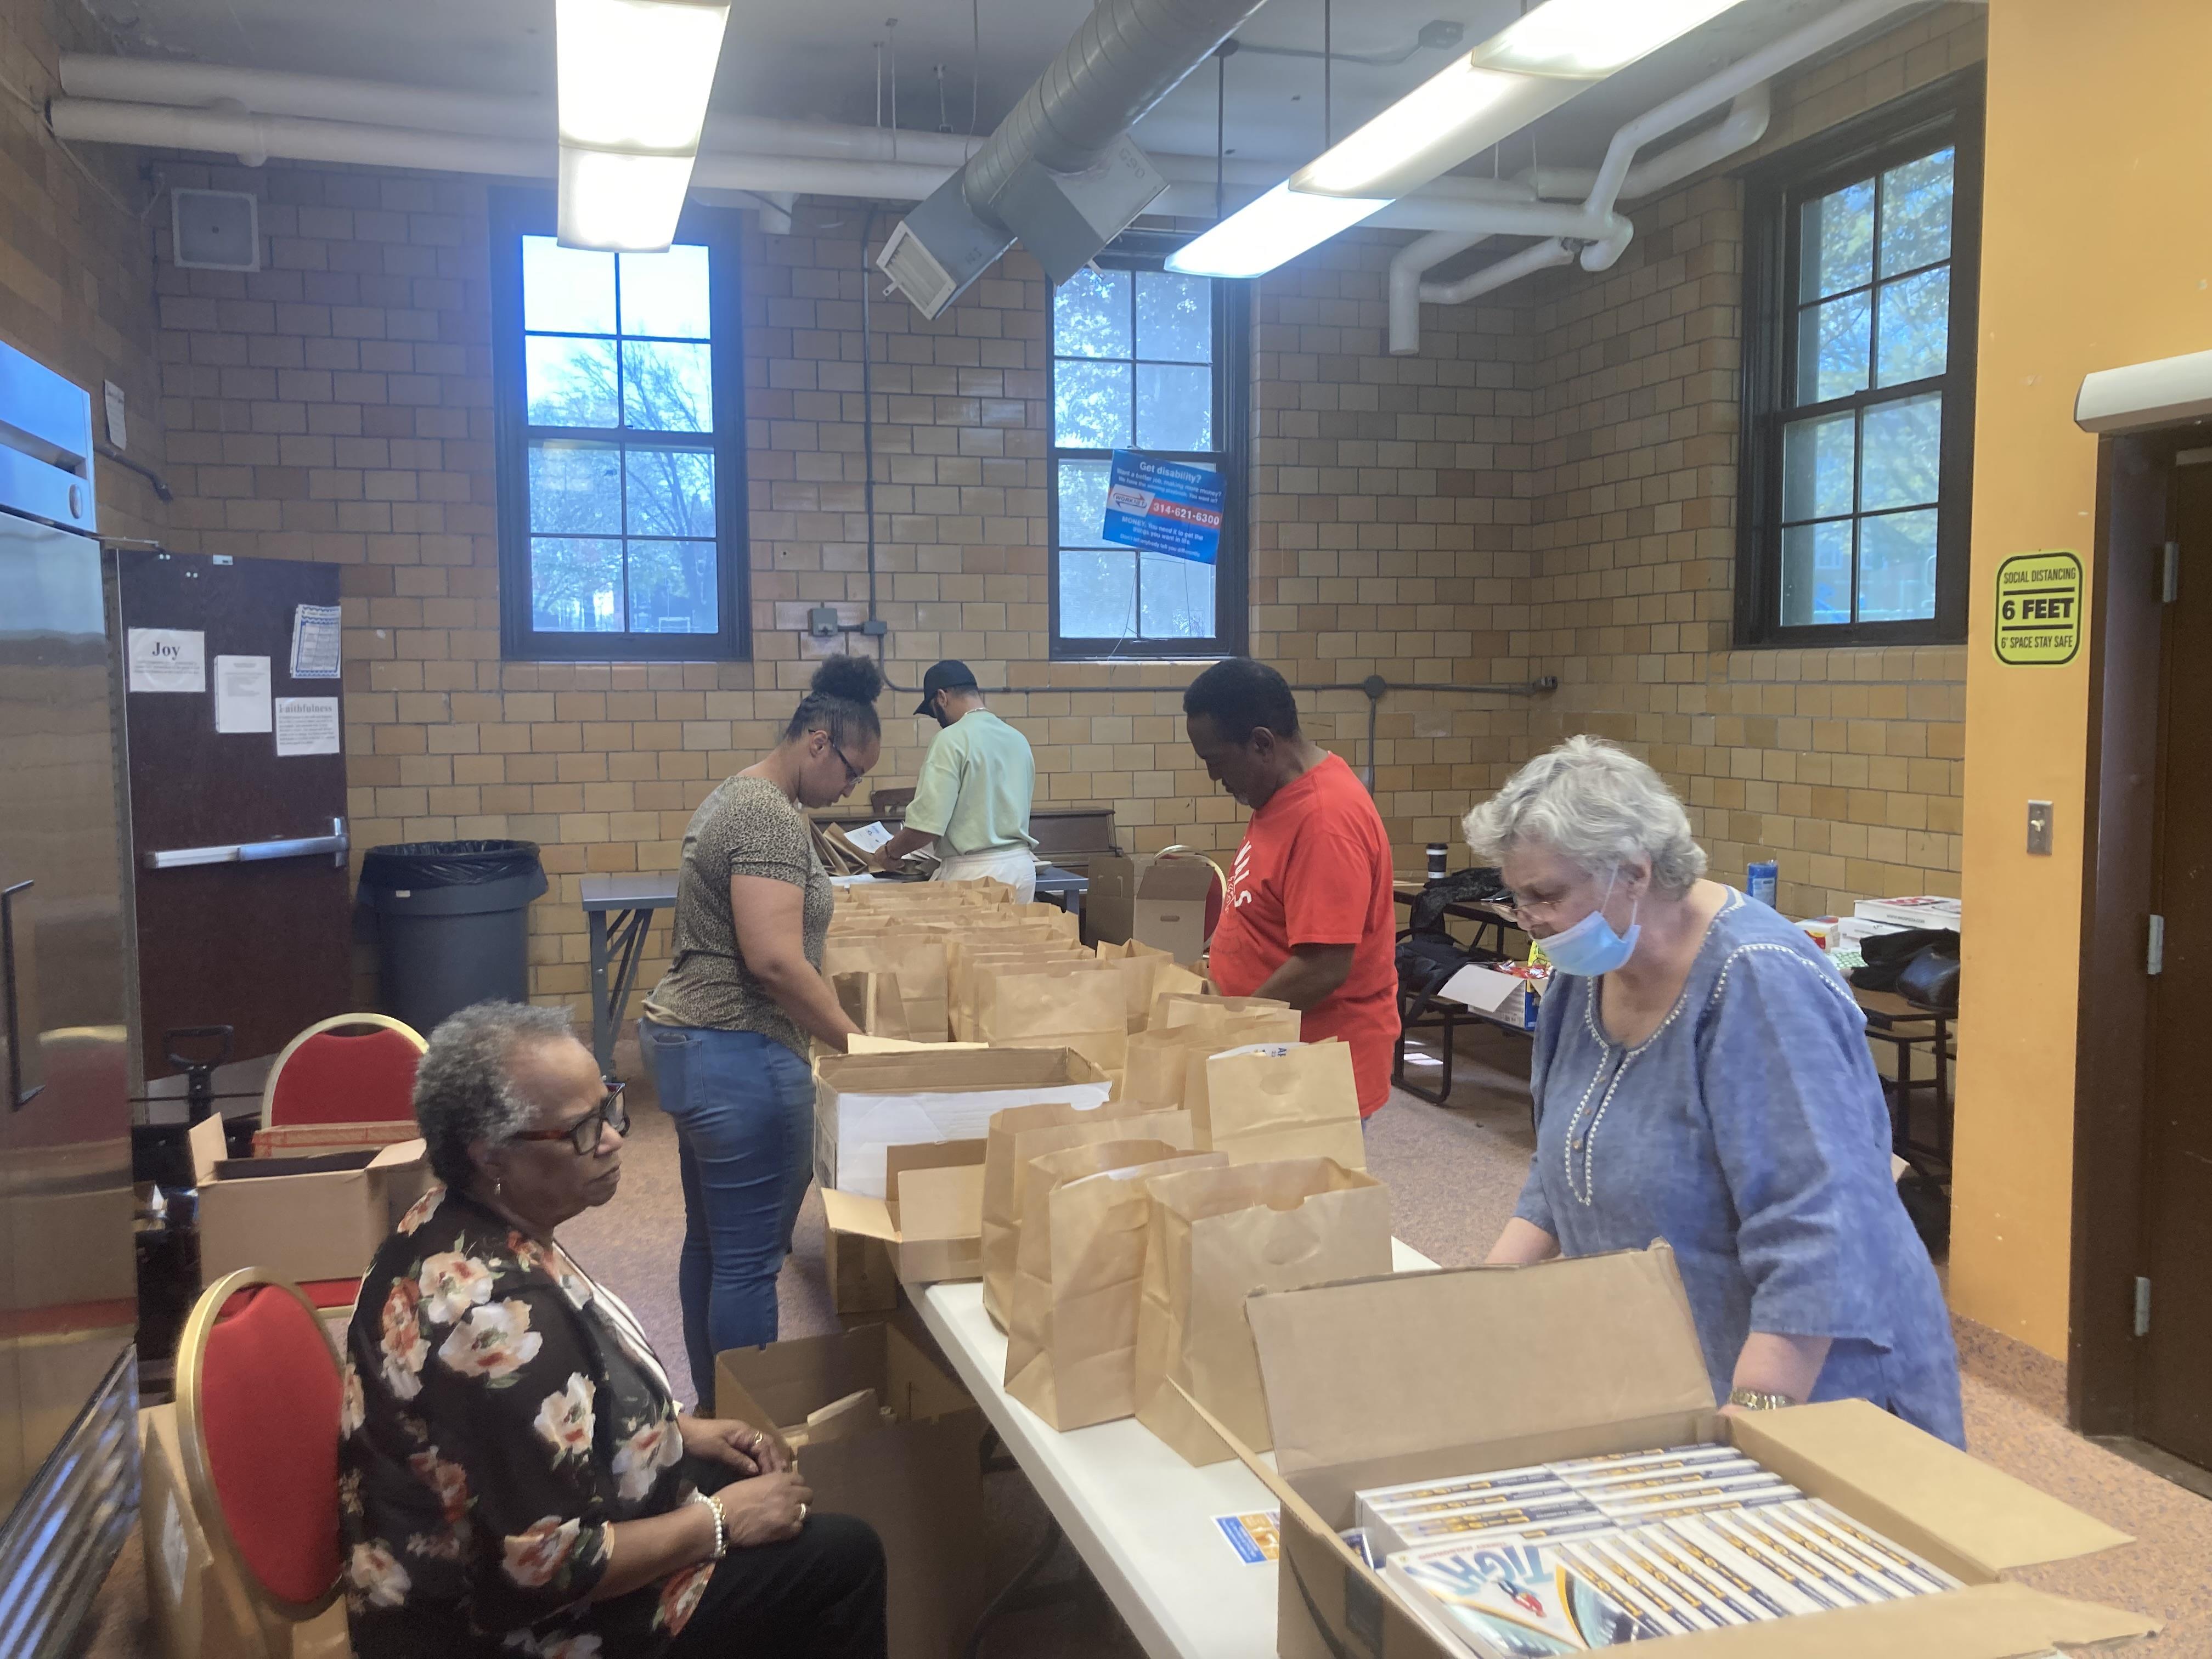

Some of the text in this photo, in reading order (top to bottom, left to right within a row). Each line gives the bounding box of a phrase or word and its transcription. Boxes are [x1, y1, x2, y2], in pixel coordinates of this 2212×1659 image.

[1117, 467, 1130, 476] Want
[1136, 472, 1152, 482] better
[1200, 489, 1222, 498] money?
[1140, 461, 1201, 484] Get disability?
[1122, 516, 1147, 527] MONEY.
[1148, 522, 1158, 531] You
[1153, 502, 1220, 526] 314-621-6300
[2004, 567, 2076, 584] SOCIAL DISTANCING
[2002, 597, 2075, 620] 6 FEET
[152, 641, 180, 661] Joy
[2001, 635, 2074, 649] 6' SPACE STAY SAFE
[279, 703, 332, 713] Faithfulness
